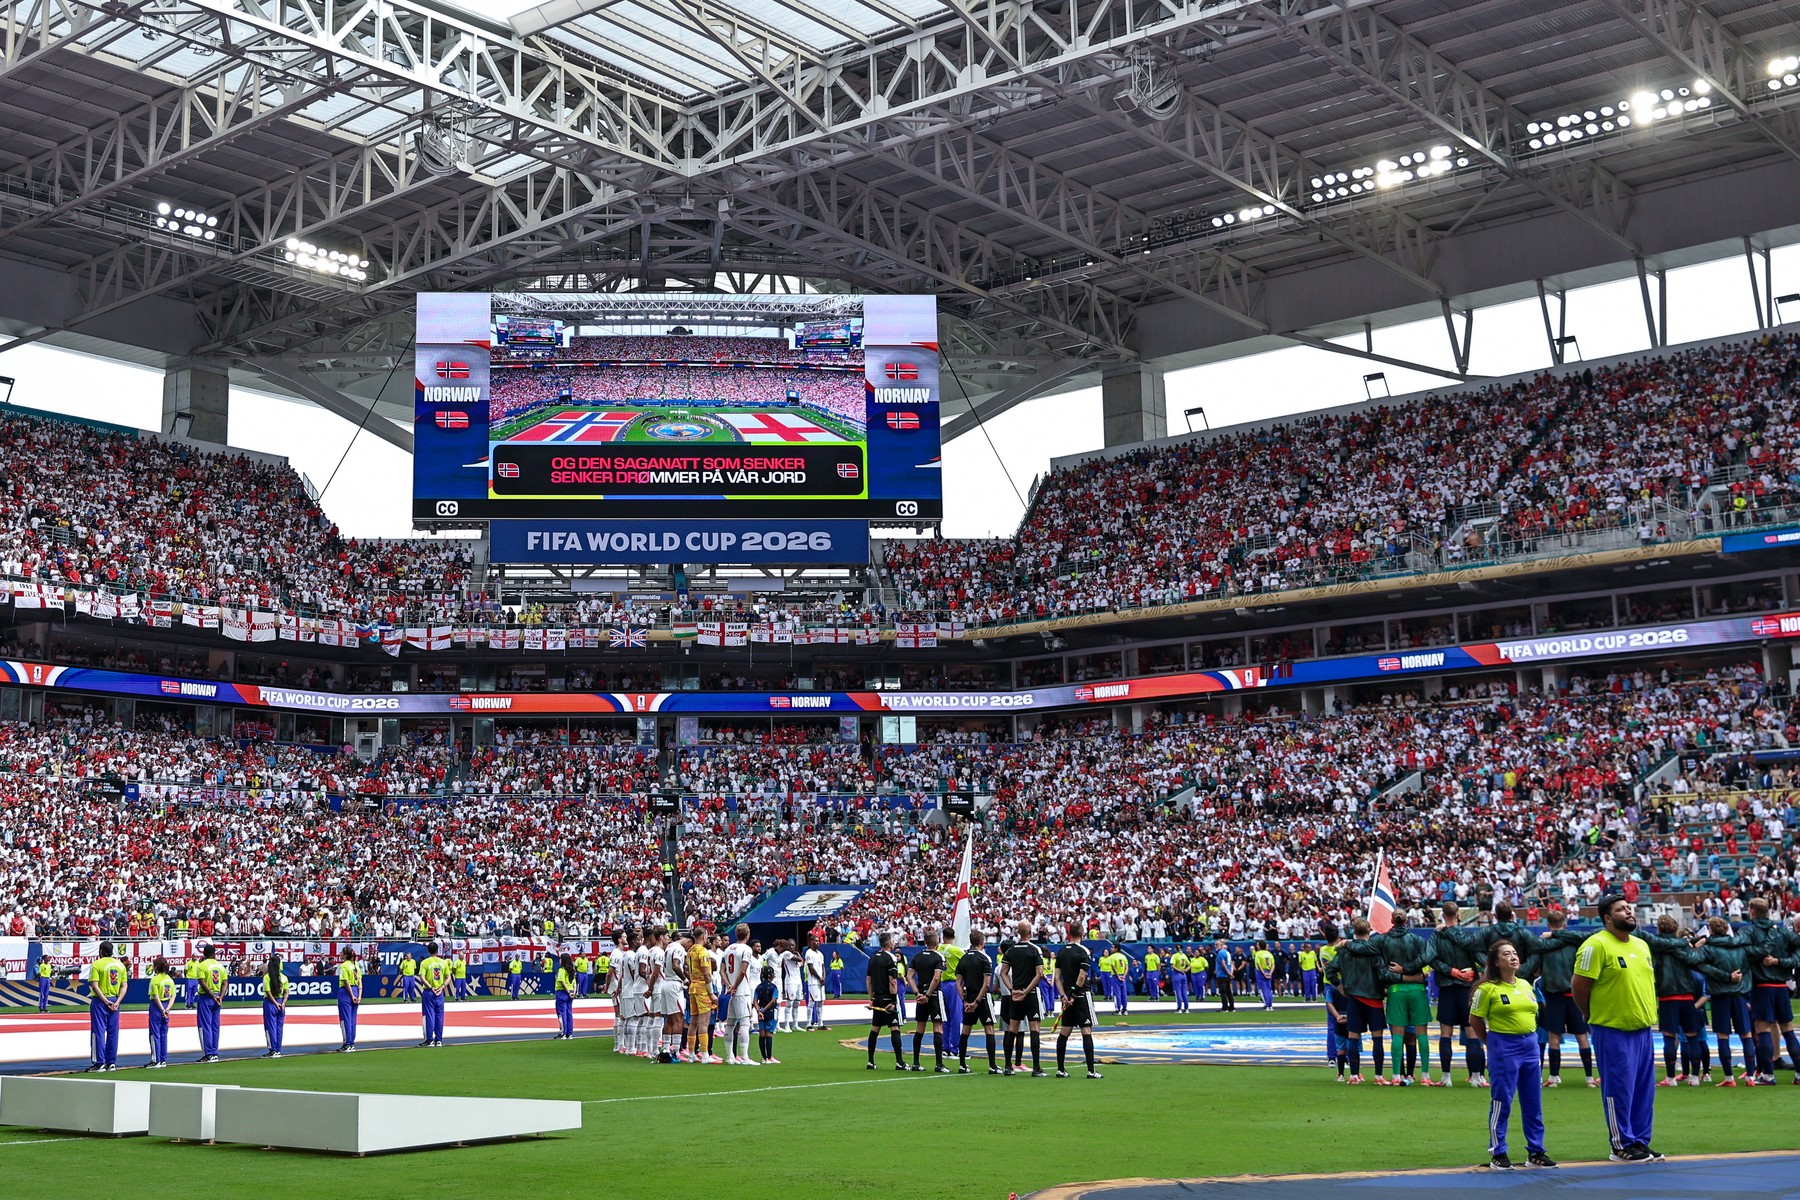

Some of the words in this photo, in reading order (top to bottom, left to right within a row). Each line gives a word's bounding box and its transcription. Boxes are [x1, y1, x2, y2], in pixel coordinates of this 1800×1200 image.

[424, 386, 480, 402] NORWAY
[874, 388, 930, 403] NORWAY
[551, 457, 576, 470] OG
[579, 457, 611, 470] DEN
[614, 457, 700, 470] SAGANATT
[703, 457, 740, 470] SOM
[743, 457, 805, 470] SENKER
[550, 471, 613, 484] SENKER
[616, 470, 700, 484] DRØMMER
[702, 469, 724, 484] PÅ
[726, 469, 758, 484] VÅR
[762, 471, 806, 484] JORD
[438, 503, 456, 514] CC
[898, 503, 916, 514] CC
[528, 532, 582, 550] FIFA
[586, 532, 680, 551] WORLD
[685, 532, 736, 551] CUP
[741, 532, 832, 550] 2026
[1500, 645, 1534, 660] FIFA
[1534, 639, 1592, 656] WORLD
[1594, 635, 1626, 649] CUP
[1629, 628, 1688, 646] 2026
[1401, 653, 1444, 669] NORWAY
[181, 682, 217, 697] NORWAY
[1094, 684, 1129, 698] NORWAY
[260, 690, 284, 703] FIFA
[286, 692, 326, 706] WORLD
[327, 697, 350, 708] CUP
[352, 698, 400, 708] 2026
[472, 698, 512, 708] NORWAY
[792, 696, 831, 708] NORWAY
[880, 696, 910, 706] FIFA
[911, 696, 960, 706] WORLD
[962, 696, 988, 706] CUP
[990, 694, 1034, 706] 2026
[6, 960, 26, 972] OWN
[728, 953, 734, 974] 9
[288, 982, 332, 995] 2026
